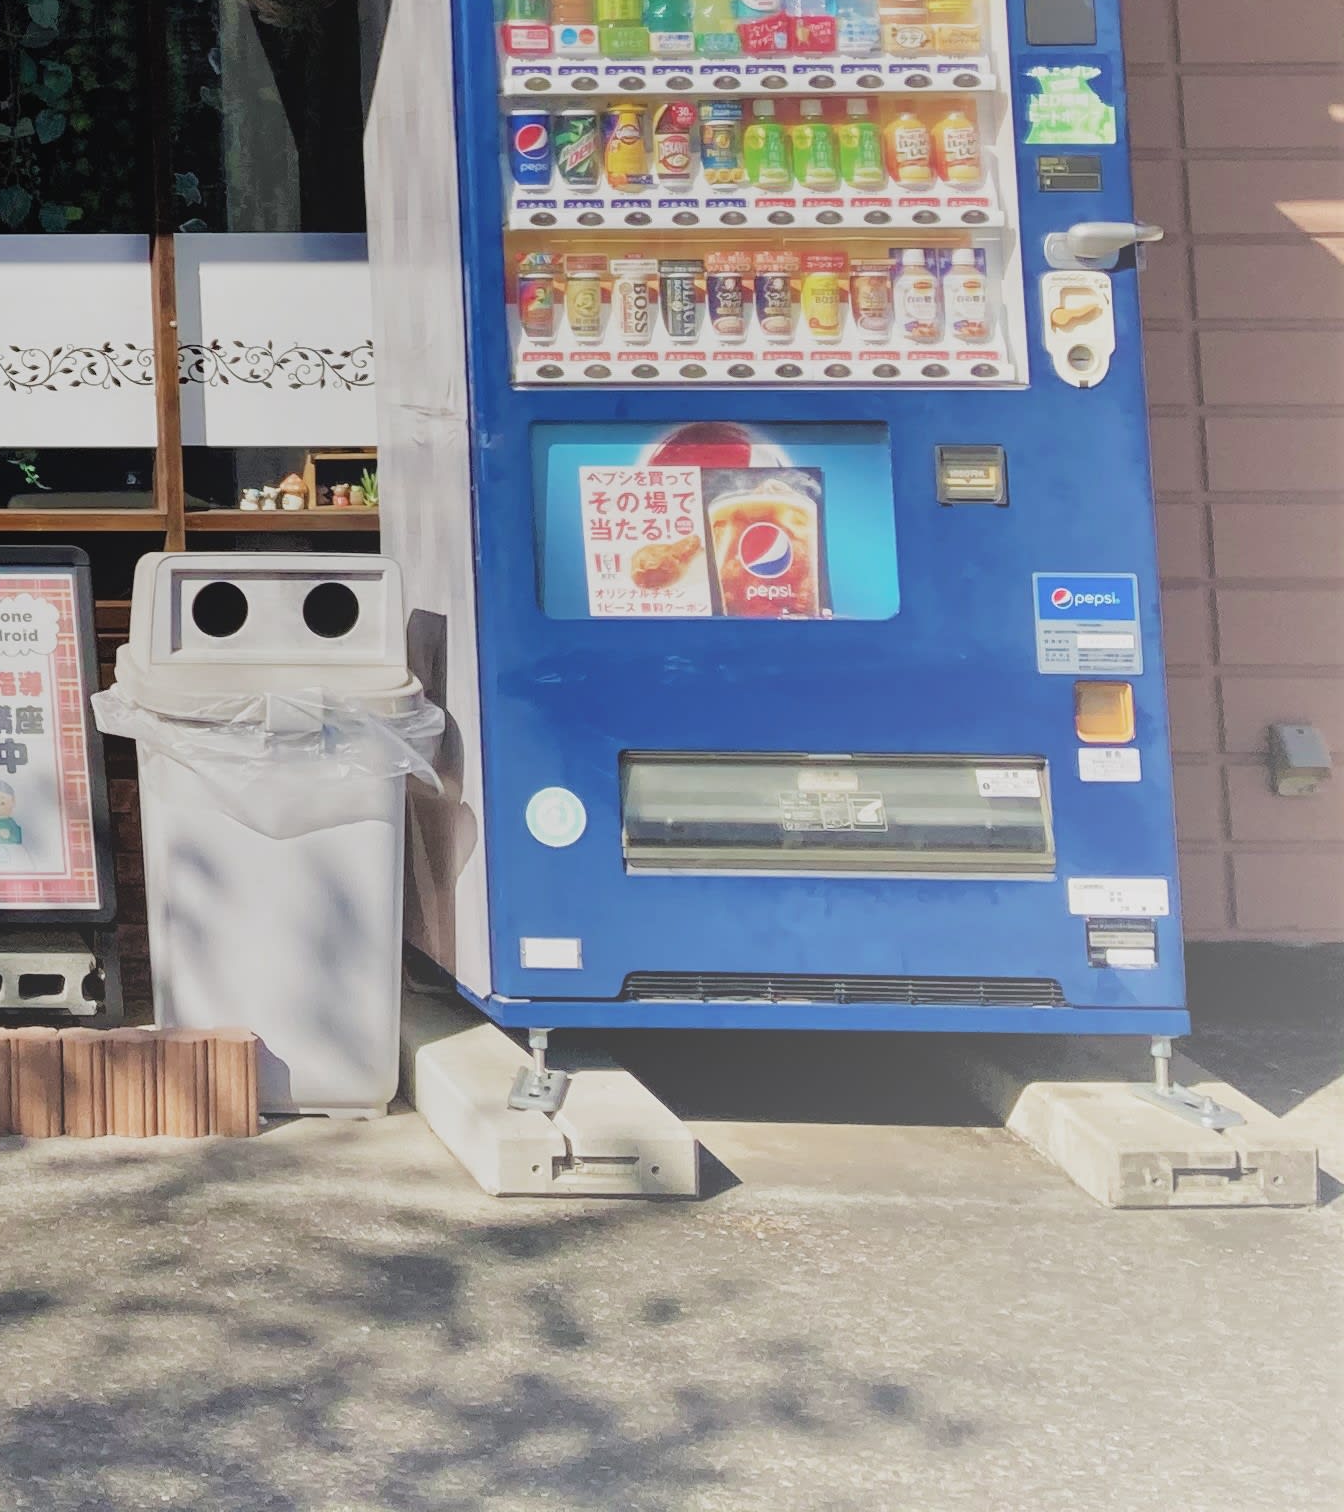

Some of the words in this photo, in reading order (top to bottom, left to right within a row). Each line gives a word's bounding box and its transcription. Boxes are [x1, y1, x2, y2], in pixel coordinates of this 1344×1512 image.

[633, 283, 649, 333] BOSS
[589, 491, 696, 515] その場で
[747, 583, 792, 601] pepsi
[1075, 591, 1116, 607] pepsi
